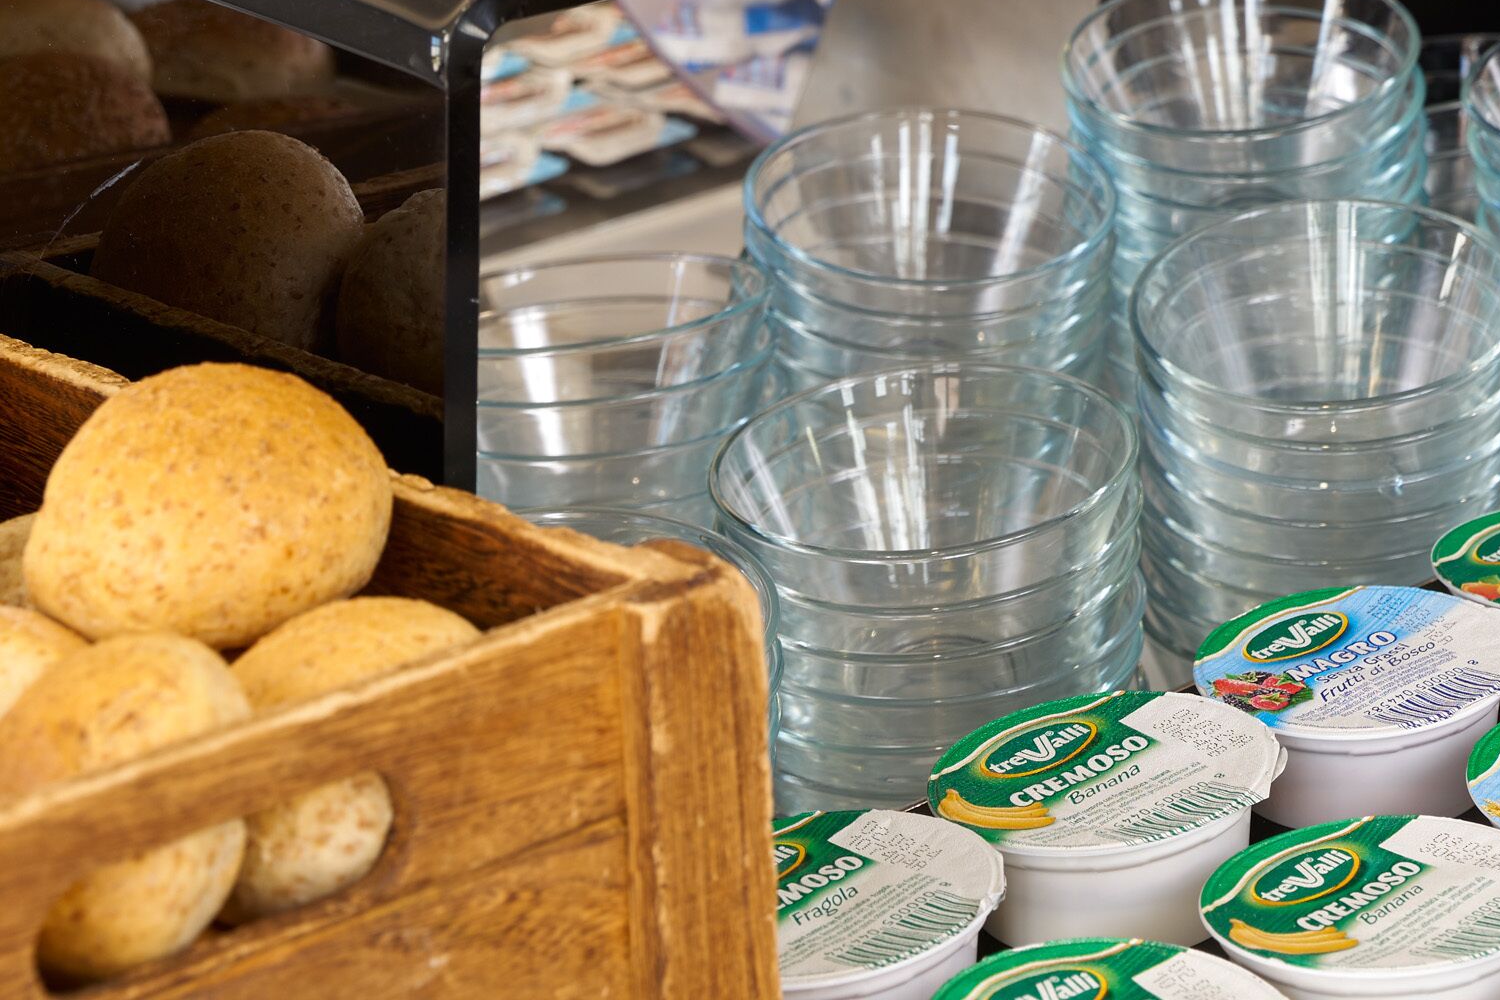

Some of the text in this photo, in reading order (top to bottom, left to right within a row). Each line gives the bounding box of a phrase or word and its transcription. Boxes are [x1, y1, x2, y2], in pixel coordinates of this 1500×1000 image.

[1286, 629, 1398, 685] MAGRO
[1320, 643, 1410, 685] Senza Grassi
[1320, 671, 1369, 704] Frutti
[1370, 664, 1387, 680] di
[1389, 640, 1437, 675] Bosco
[1009, 735, 1150, 808] CREMOSO
[1067, 762, 1142, 806] Banana
[777, 854, 864, 911] MOSO
[791, 884, 859, 927] Fragola
[1296, 860, 1423, 932] CREMOSO
[1360, 883, 1425, 926] Banana
